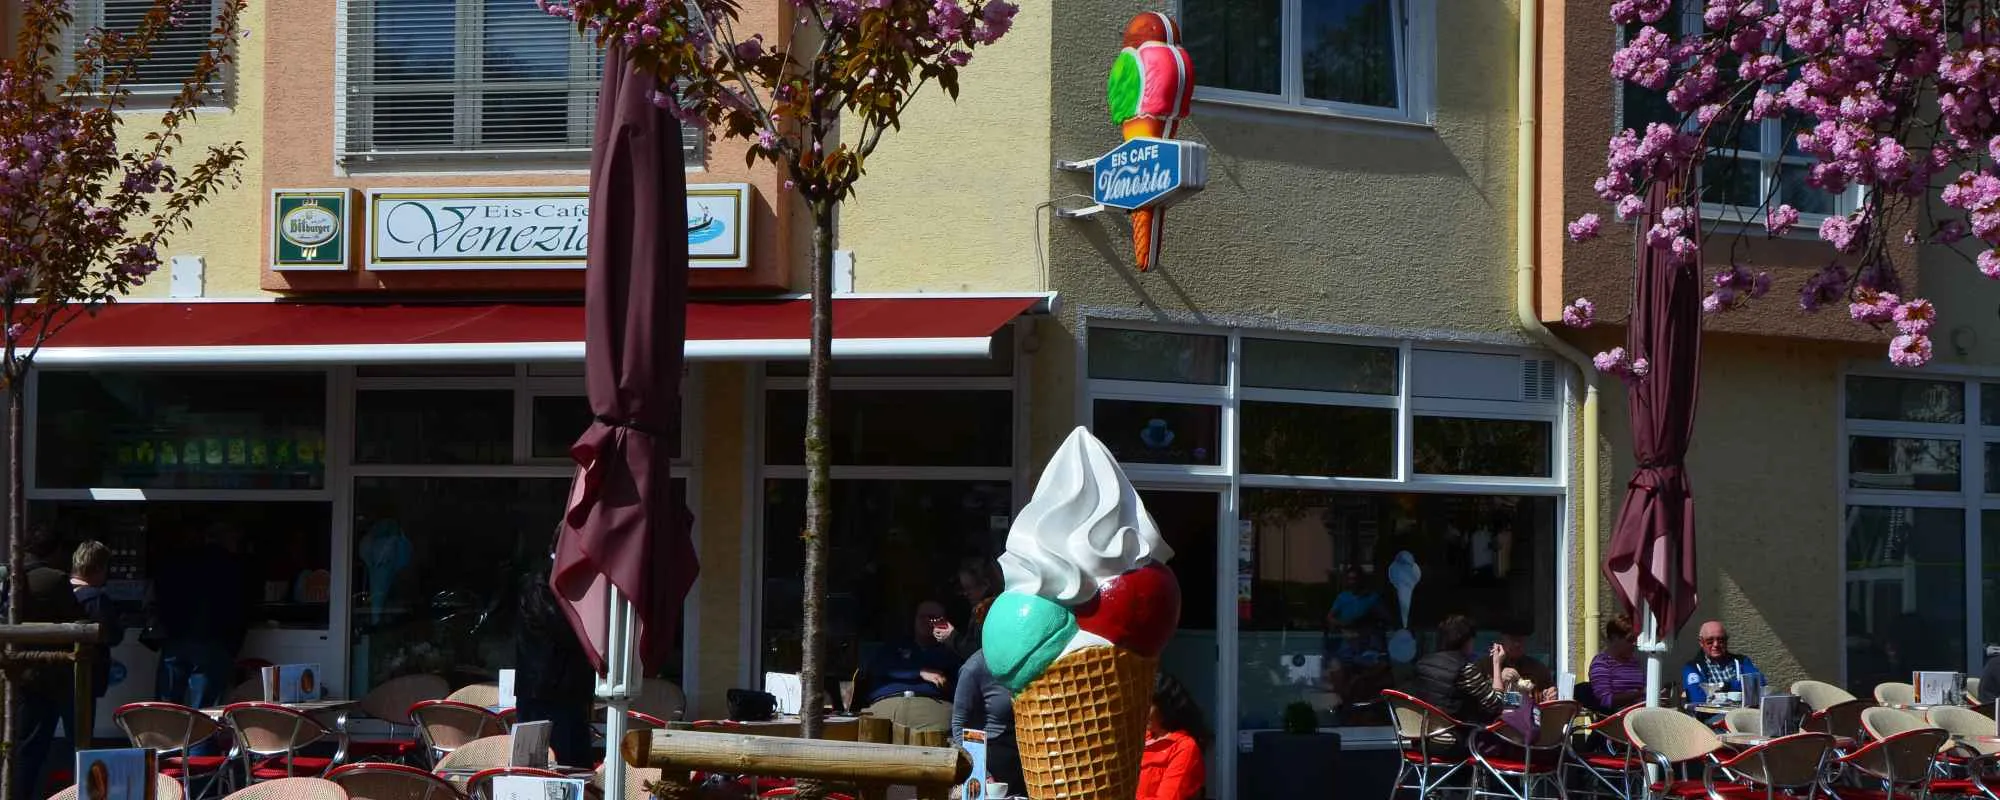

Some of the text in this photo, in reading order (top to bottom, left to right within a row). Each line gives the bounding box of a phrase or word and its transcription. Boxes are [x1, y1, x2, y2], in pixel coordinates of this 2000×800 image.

[1111, 144, 1159, 167] EIS CAFE
[1098, 162, 1172, 202] Venezia
[290, 218, 330, 234] Bitburger
